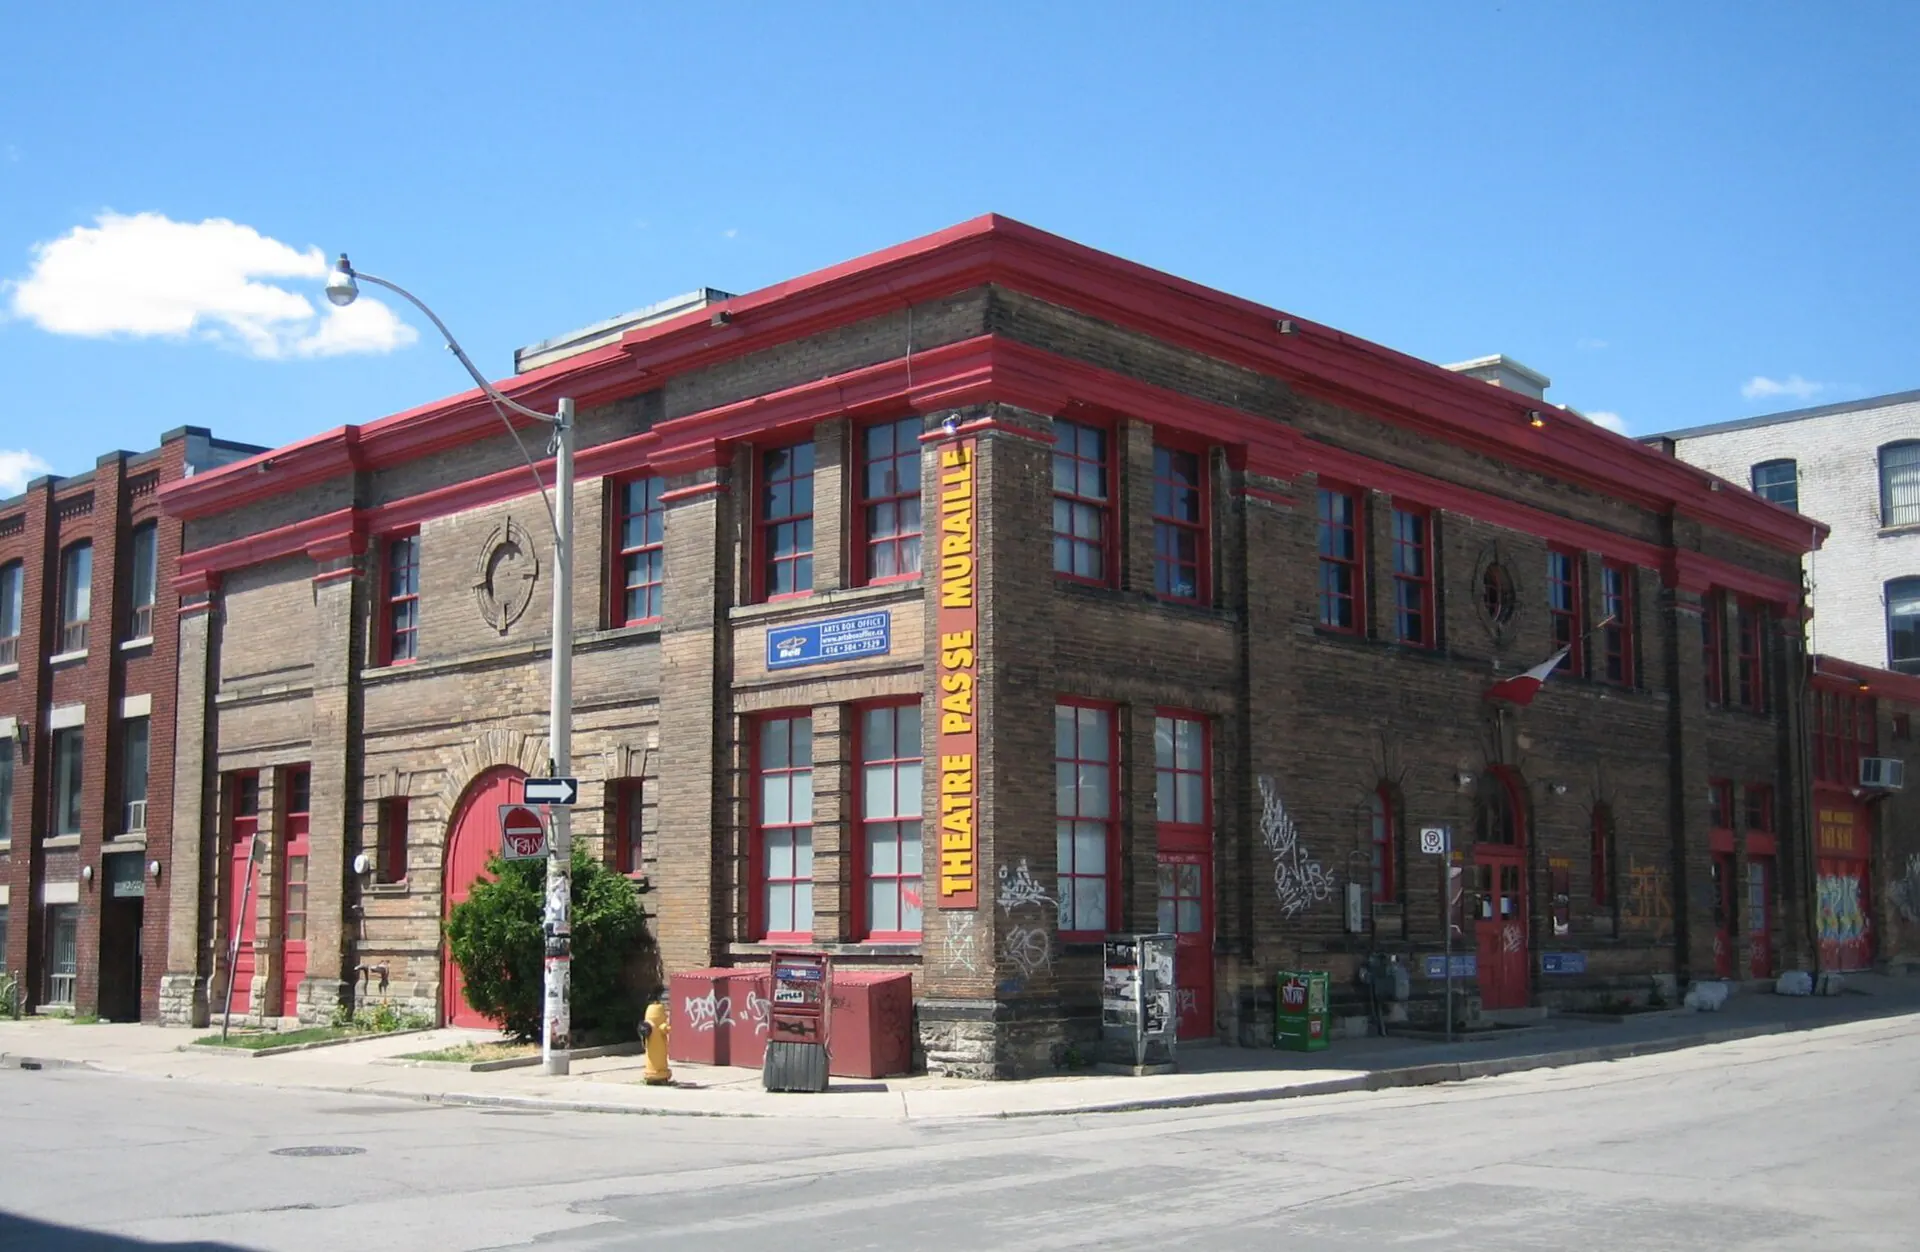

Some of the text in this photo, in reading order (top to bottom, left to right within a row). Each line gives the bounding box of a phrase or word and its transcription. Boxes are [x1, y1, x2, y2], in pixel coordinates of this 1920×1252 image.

[941, 446, 973, 608] MURAILLE
[780, 647, 801, 658] Bell
[823, 617, 881, 634] ARTS BOX OFFICE
[941, 630, 973, 734] PASSE
[941, 754, 973, 896] THEATRE
